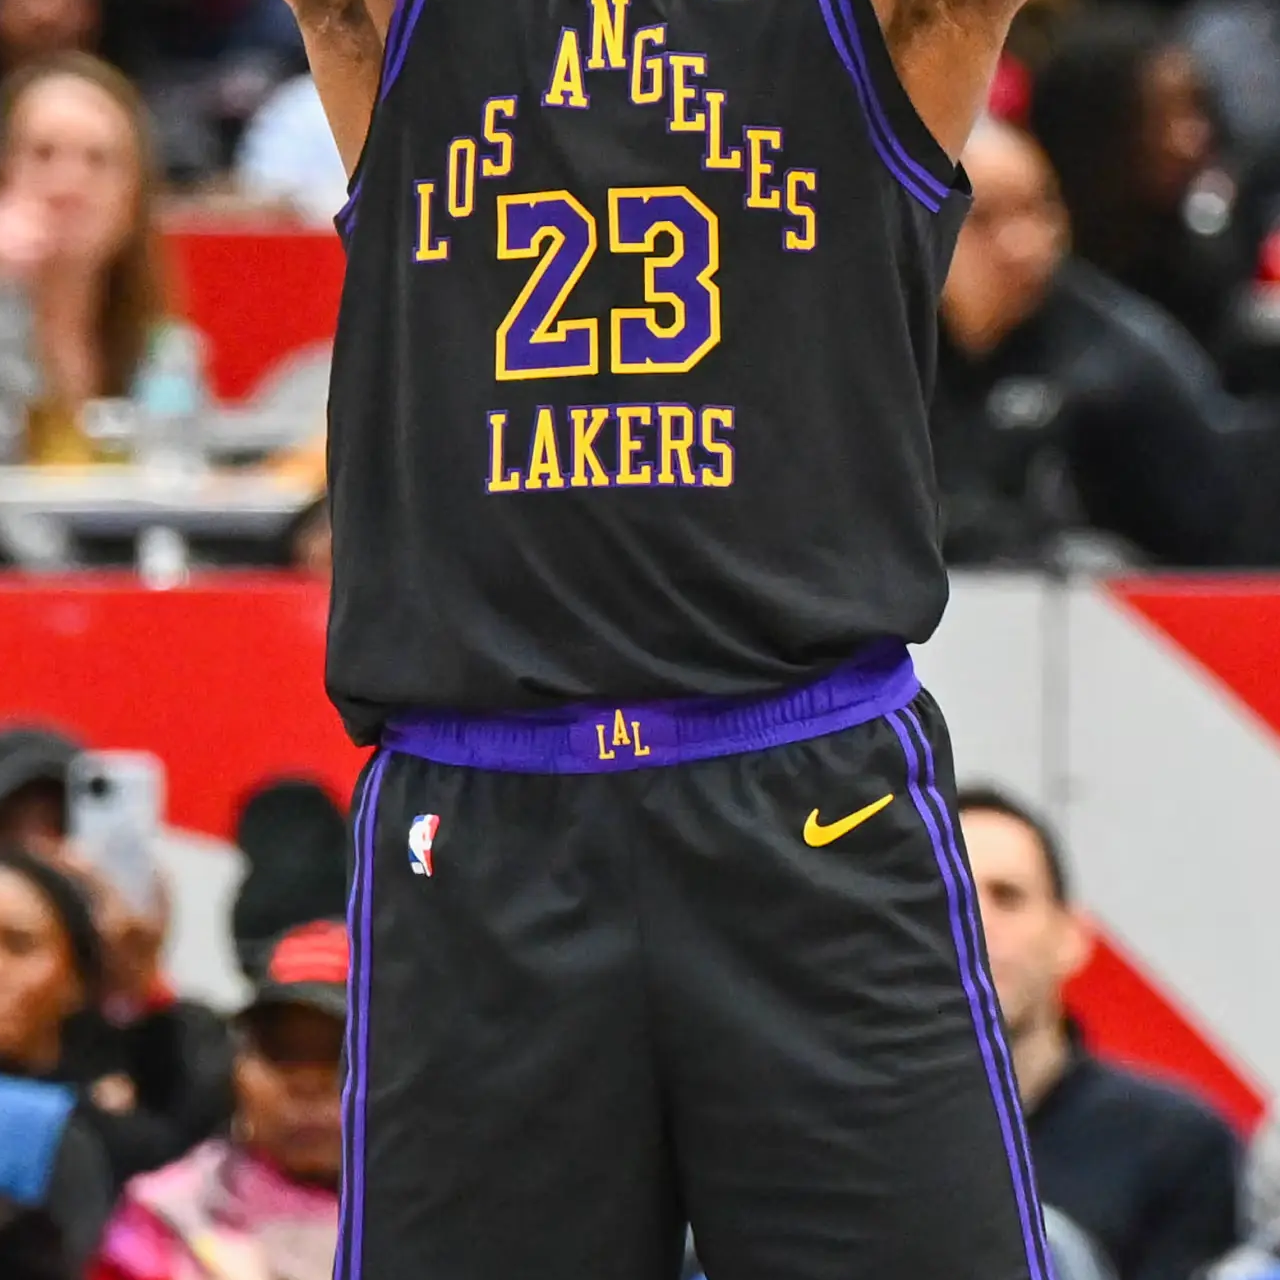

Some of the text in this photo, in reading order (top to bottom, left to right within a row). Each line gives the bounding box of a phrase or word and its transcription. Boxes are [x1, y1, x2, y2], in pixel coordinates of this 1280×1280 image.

[413, 95, 519, 262] LOS
[495, 186, 720, 381] 23
[485, 404, 735, 495] LAKERS
[595, 708, 651, 760] LAL
